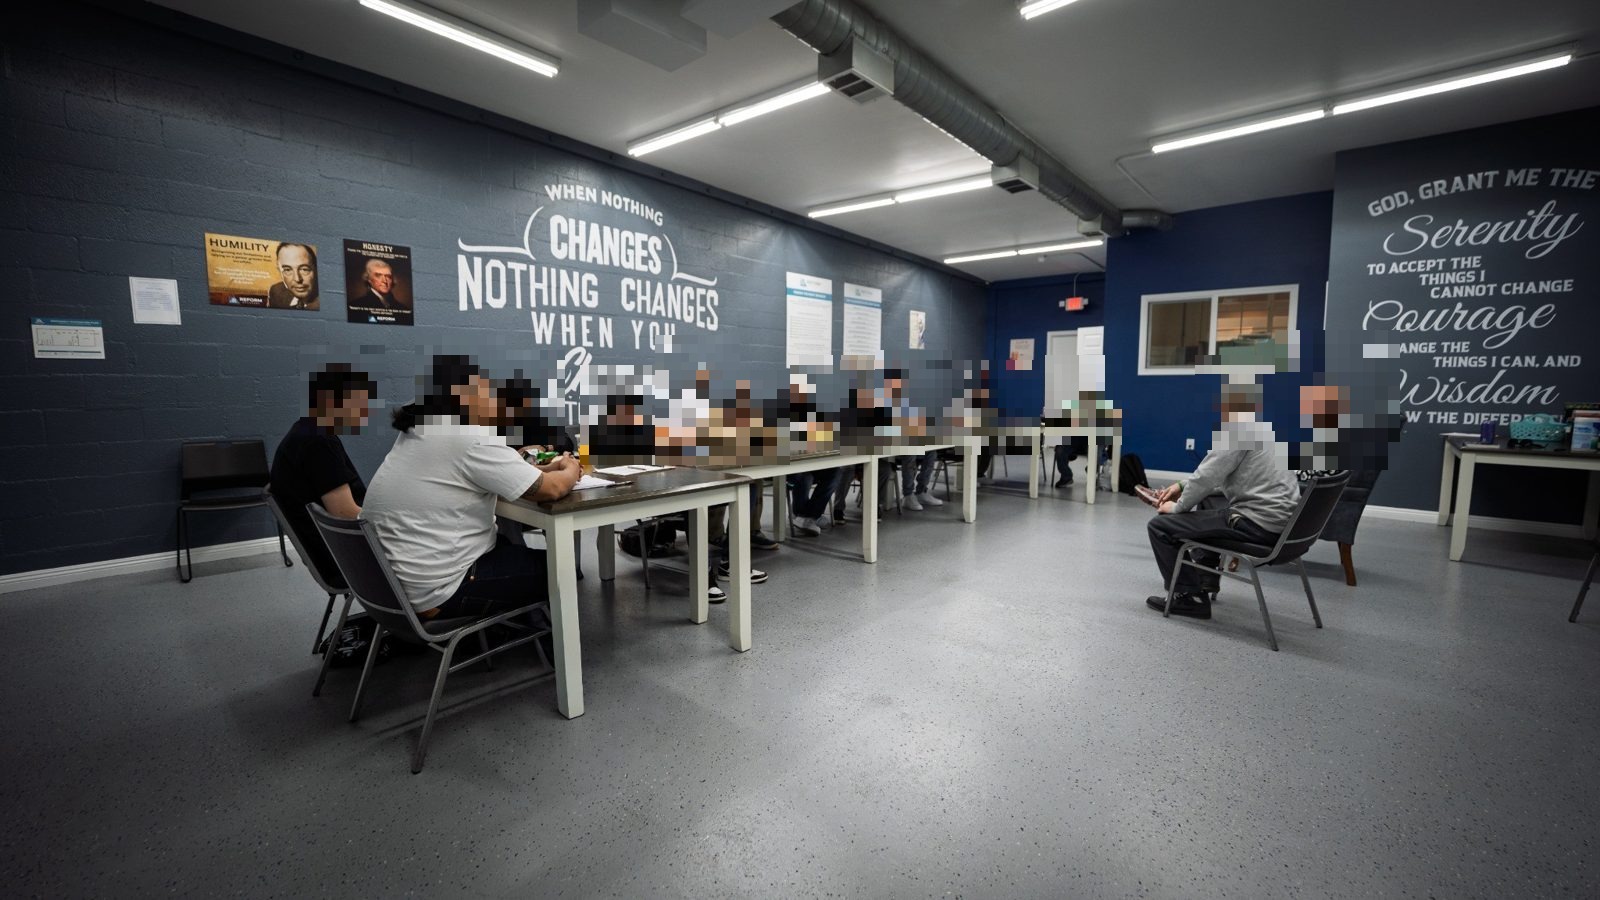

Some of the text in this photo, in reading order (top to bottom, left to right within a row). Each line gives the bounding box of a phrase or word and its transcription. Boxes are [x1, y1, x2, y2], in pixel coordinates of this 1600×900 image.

[544, 184, 664, 227] WHEN NOTHING
[1367, 168, 1600, 217] GOD, GRANT ME THE
[1383, 199, 1584, 260] Serenity
[209, 237, 269, 252] HUMILITY
[362, 242, 394, 253] HONESTY
[549, 214, 662, 275] CHANGES
[1367, 255, 1482, 276] TO ACCEPT THE
[1419, 270, 1486, 286] THINGS I
[457, 253, 719, 332] NOTHING CHANGES
[1430, 279, 1574, 299] CANNOT CHANGE
[531, 311, 614, 349] WHEN
[1362, 300, 1556, 350] Courage
[1399, 342, 1437, 354] ANGE
[1440, 341, 1470, 353] THE
[1433, 355, 1582, 369] THINGS I CAN, AND
[1399, 368, 1560, 406] Wisdom
[1426, 411, 1458, 424] THE
